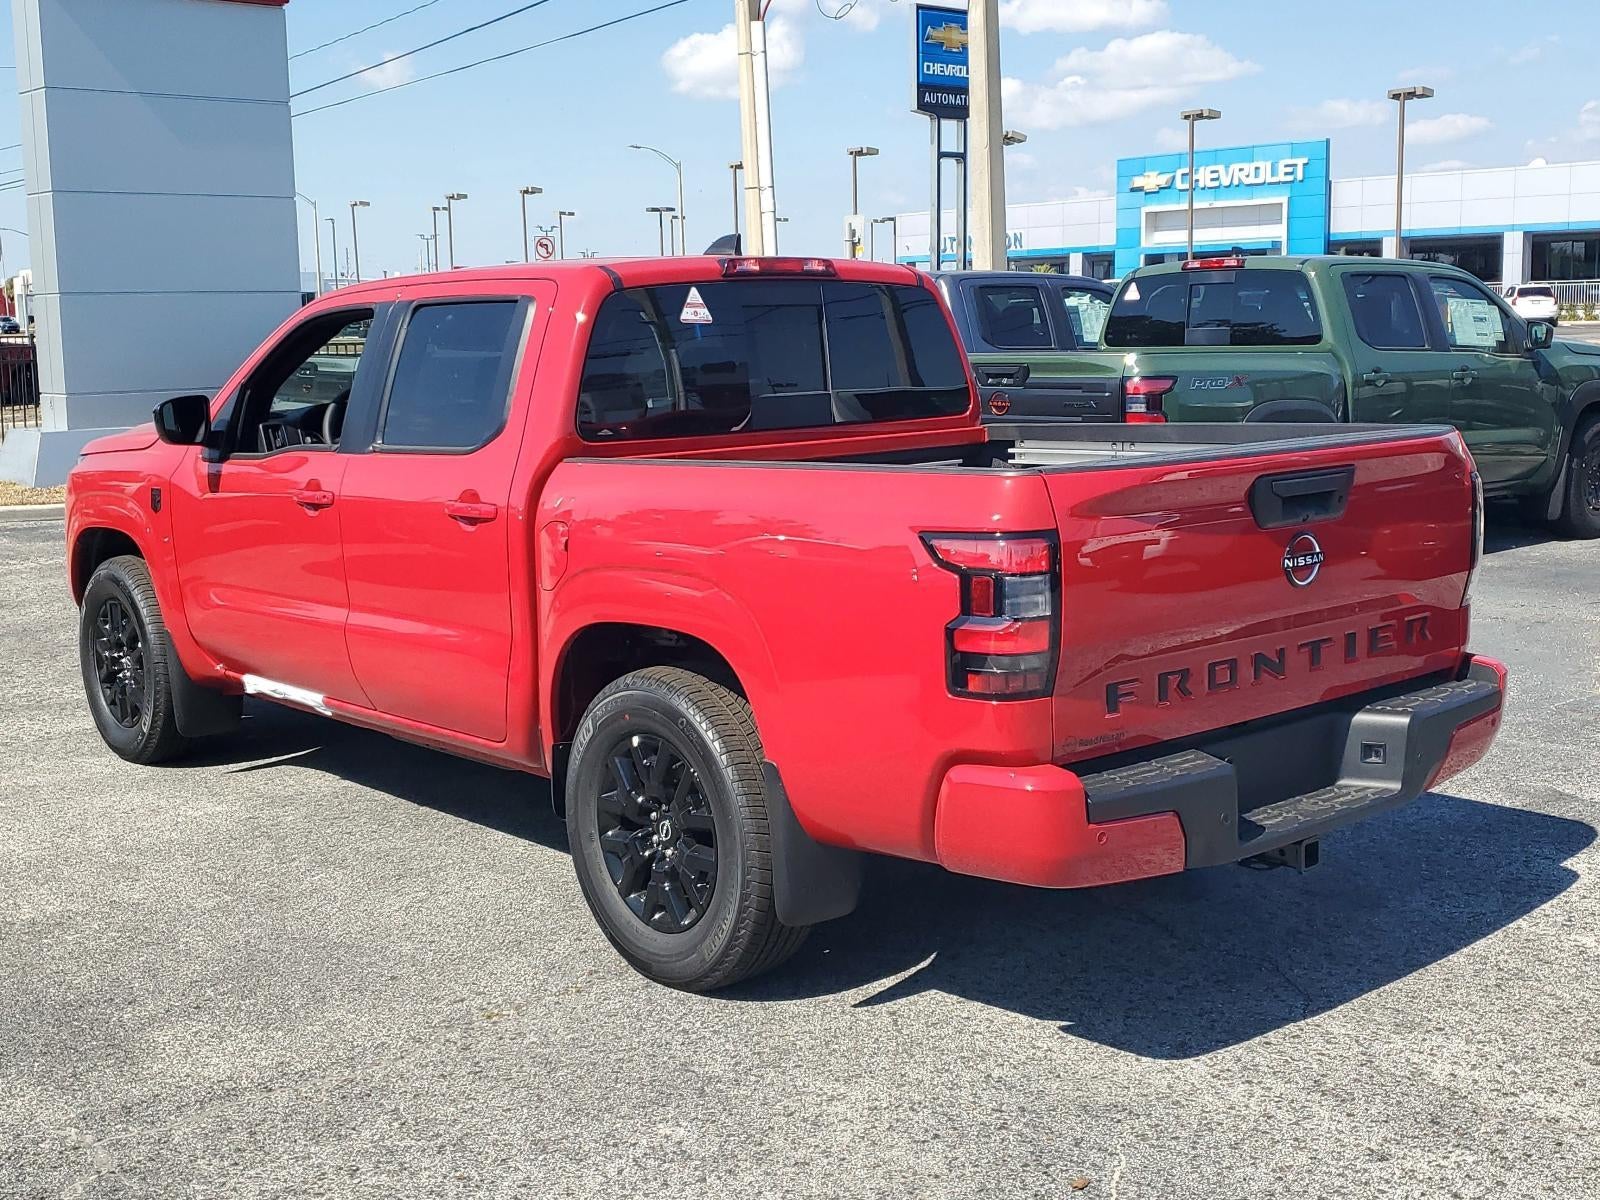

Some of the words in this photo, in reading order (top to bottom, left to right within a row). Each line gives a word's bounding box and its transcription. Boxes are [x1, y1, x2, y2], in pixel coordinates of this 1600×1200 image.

[1175, 157, 1308, 192] CHEVROLET
[1284, 553, 1324, 568] NISSAN
[1104, 611, 1432, 718] FRONTIER
